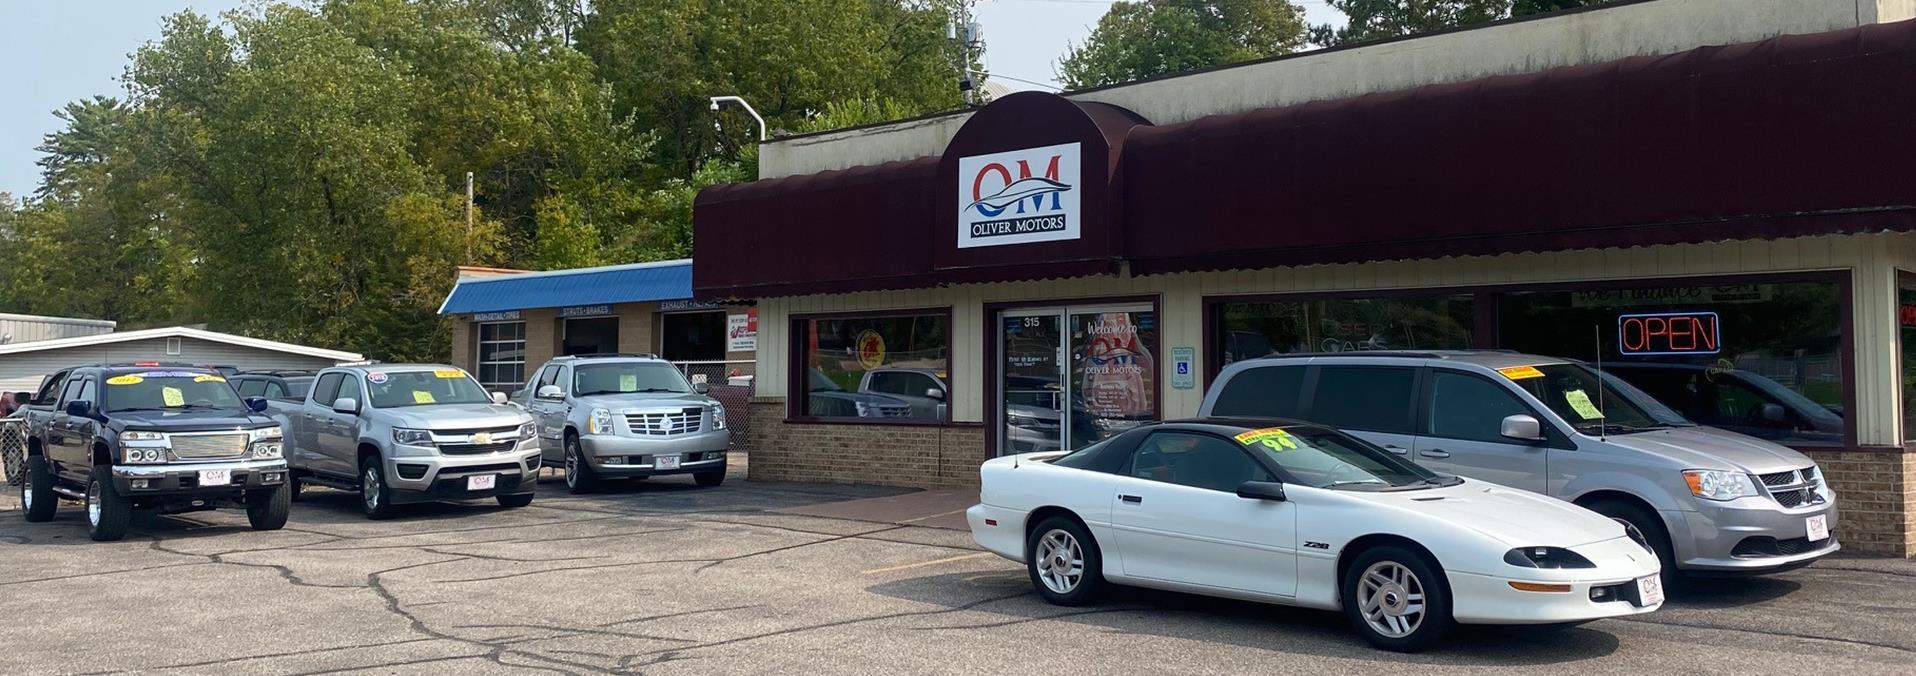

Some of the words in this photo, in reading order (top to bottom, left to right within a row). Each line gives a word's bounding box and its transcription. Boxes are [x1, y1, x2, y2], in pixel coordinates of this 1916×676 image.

[973, 155, 1062, 217] OM
[973, 222, 1012, 236] OLIVER
[1015, 216, 1064, 232] MOTORS
[661, 301, 688, 310] EXHAUST
[1024, 317, 1040, 327] 315
[1623, 317, 1715, 350] OPEN
[1303, 540, 1330, 549] Z28
